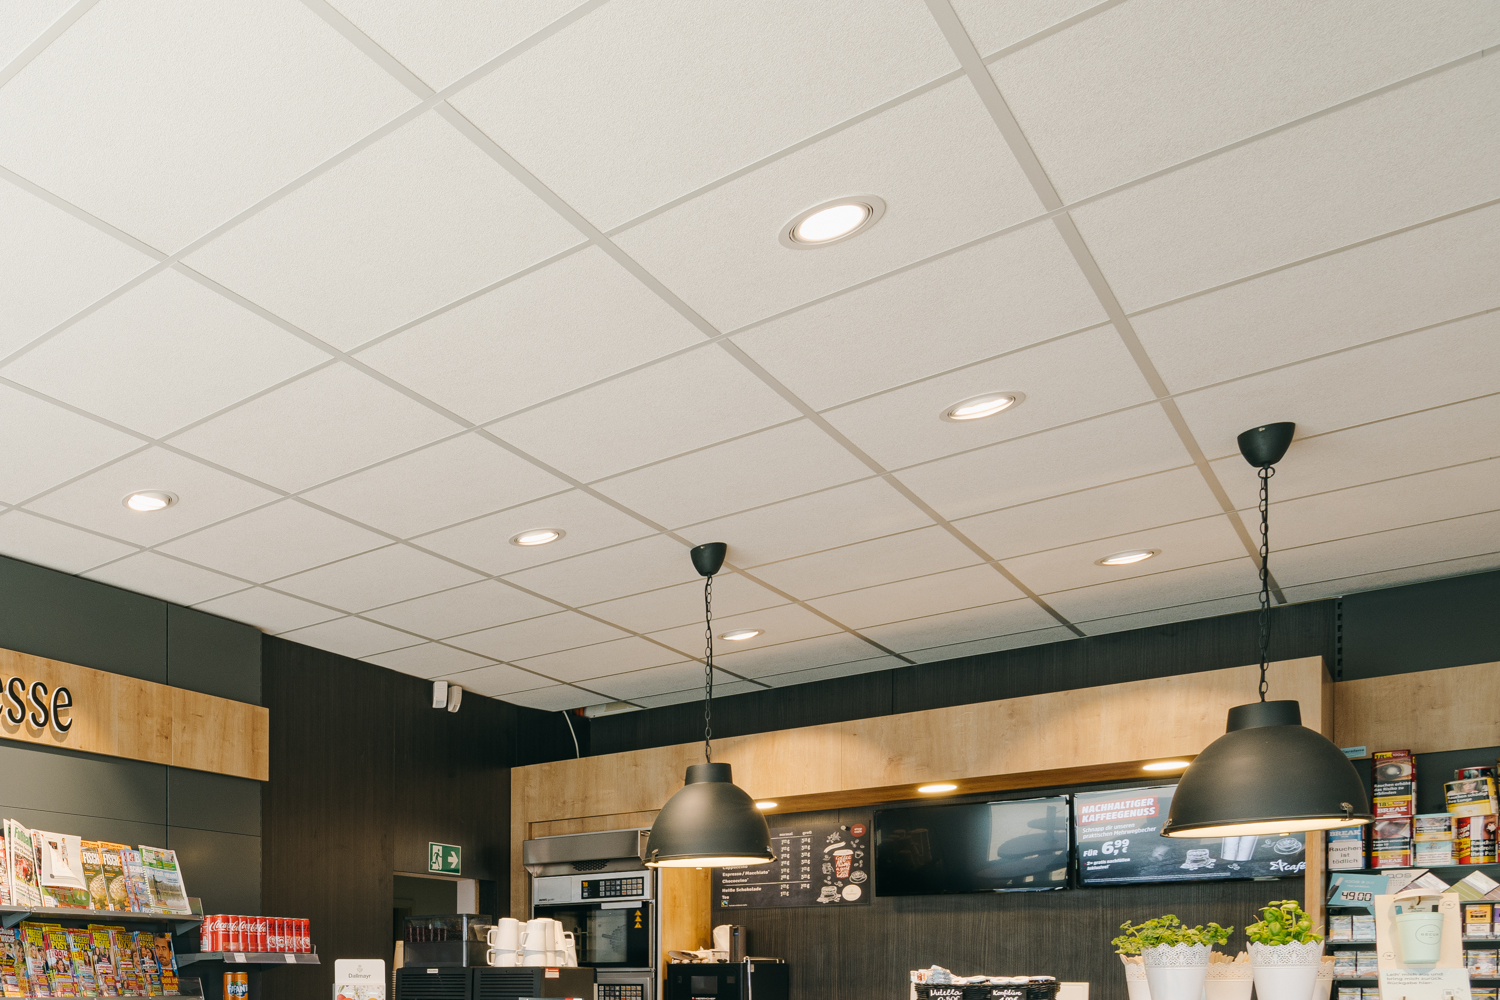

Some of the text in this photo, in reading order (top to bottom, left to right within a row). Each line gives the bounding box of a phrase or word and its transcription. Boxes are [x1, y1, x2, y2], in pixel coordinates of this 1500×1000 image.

[1082, 798, 1154, 814] NACHHALTIGER
[1377, 806, 1407, 814] BREAK
[1082, 807, 1156, 823] KAFFEEGENUSS
[1082, 826, 1105, 834] Schnapp
[1082, 826, 1157, 840] praktischen Mehrwegbecher
[1329, 829, 1361, 837] BREAK
[1083, 849, 1098, 857] FÜR
[1341, 891, 1372, 901] 49.00
[51, 941, 68, 950] POST
